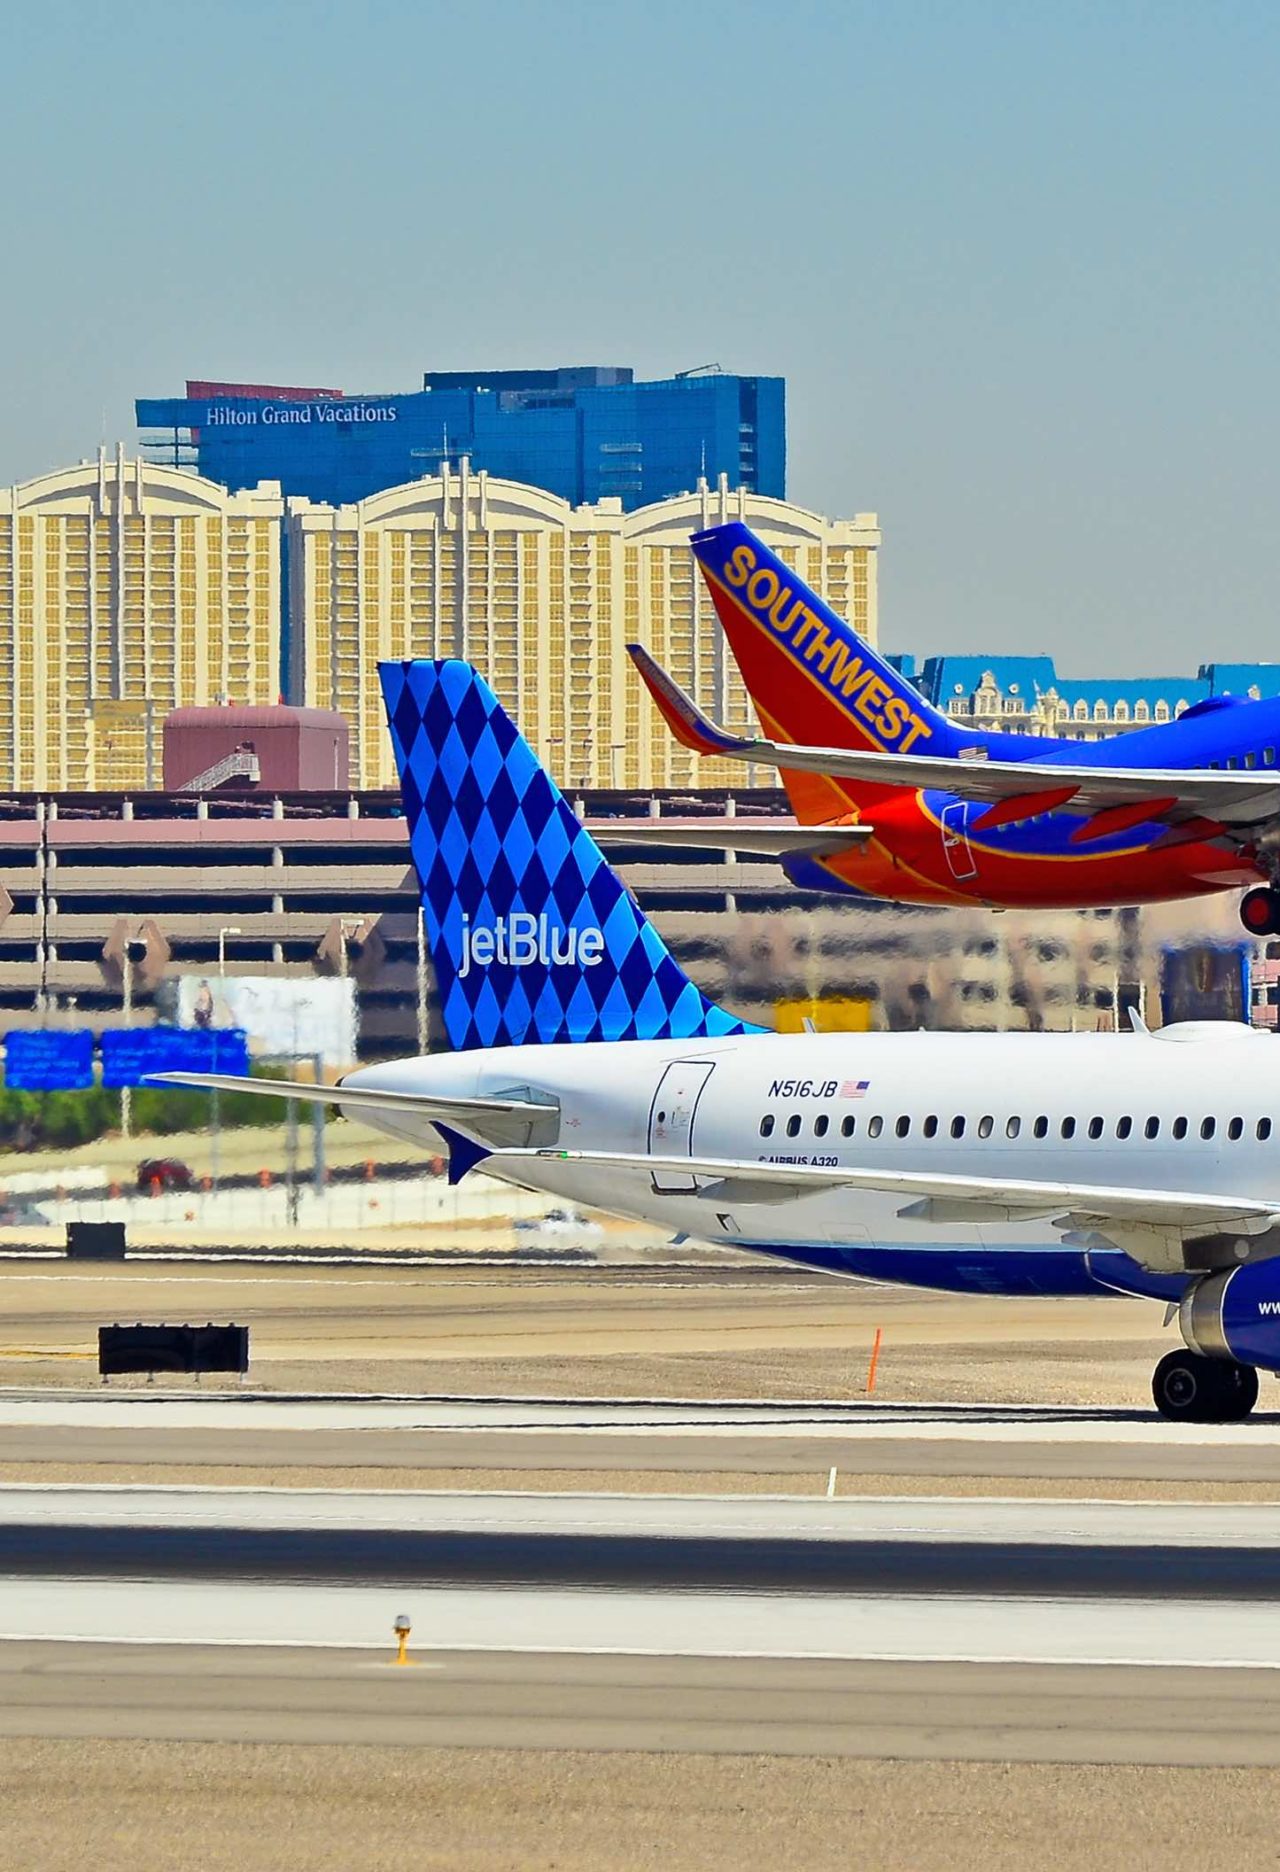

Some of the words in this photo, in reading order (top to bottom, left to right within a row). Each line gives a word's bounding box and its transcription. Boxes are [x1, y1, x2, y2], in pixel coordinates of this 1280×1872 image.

[206, 407, 257, 425] Hilton
[261, 405, 312, 424] Grand
[316, 403, 397, 423] Vacations
[723, 544, 933, 754] SOUTHWEST
[458, 912, 605, 979] jetBlue
[768, 1080, 838, 1098] N516JB
[768, 1155, 808, 1166] AIRBUS
[810, 1156, 839, 1168] A320
